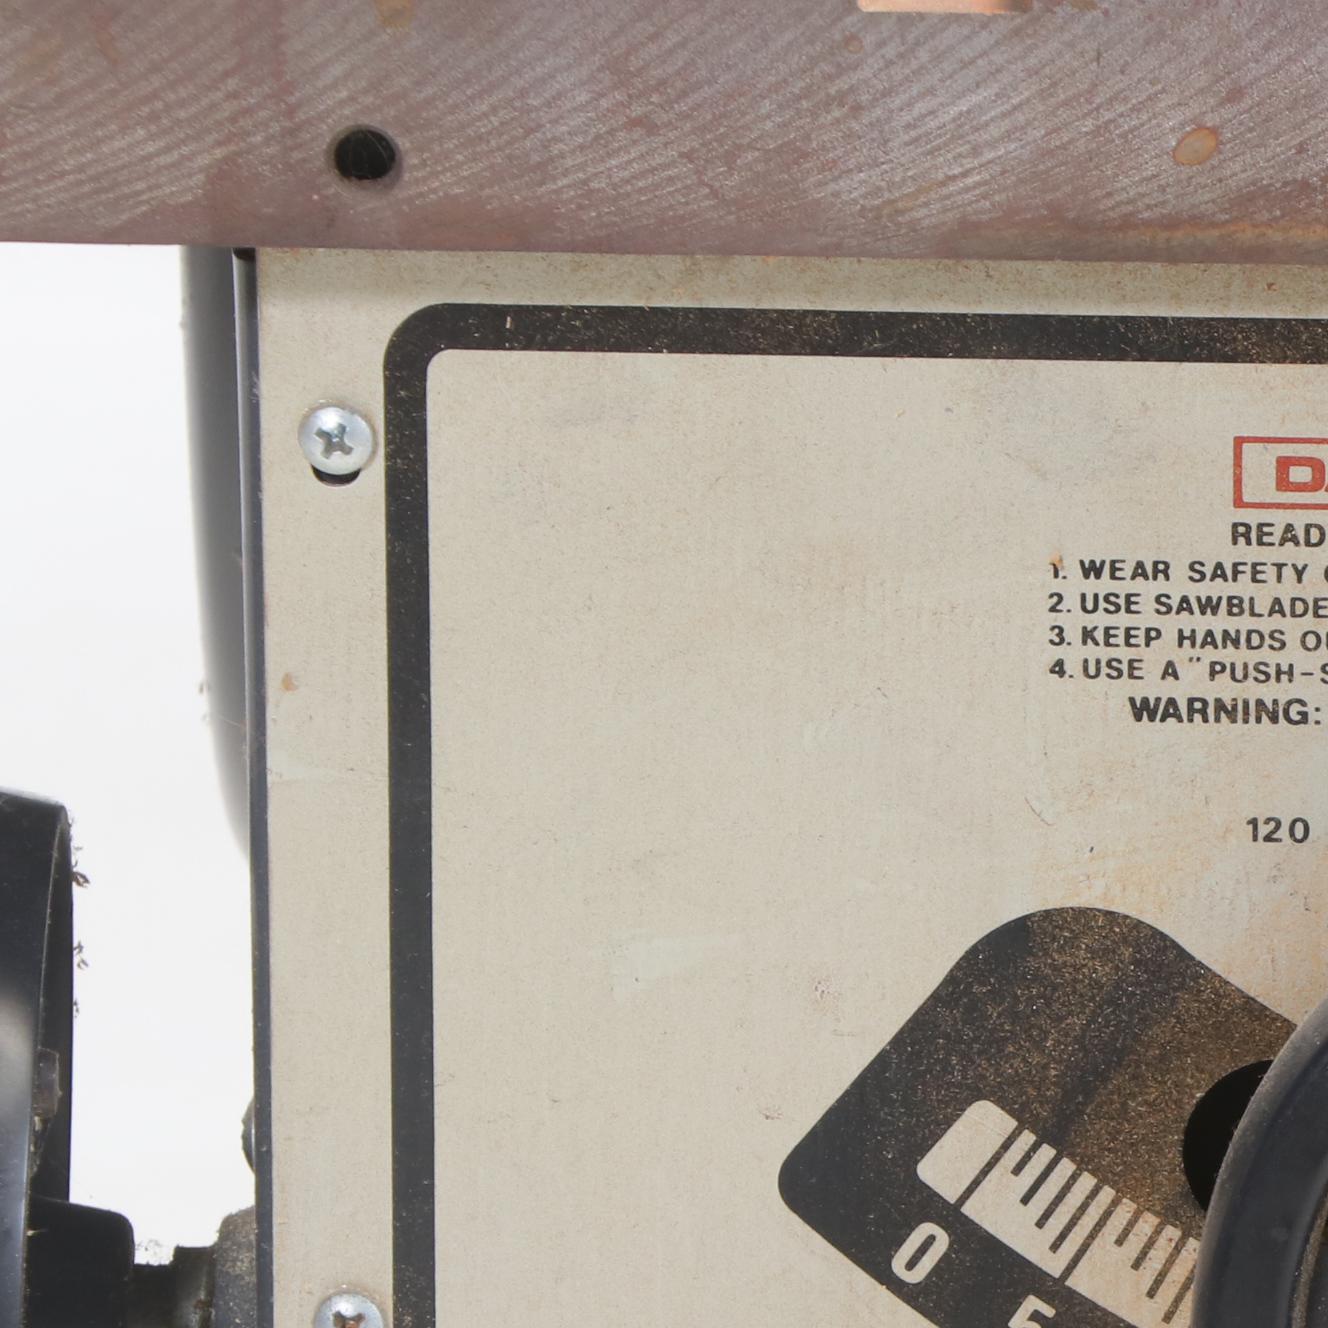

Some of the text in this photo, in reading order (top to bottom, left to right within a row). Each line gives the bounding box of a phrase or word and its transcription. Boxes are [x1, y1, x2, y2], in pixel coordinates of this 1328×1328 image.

[1231, 522, 1327, 548] READ
[1048, 561, 1068, 581] 1.
[1079, 559, 1171, 582] WEAR
[1188, 560, 1309, 585] SAFETY
[1047, 592, 1073, 614] 2.
[1080, 592, 1143, 615] USE
[1048, 625, 1073, 647] 3.
[1081, 625, 1163, 649] KEEP
[1177, 628, 1287, 652] HANDS
[1048, 658, 1074, 679] 4.
[1082, 658, 1145, 681] USE
[1160, 660, 1181, 682] A
[1128, 696, 1322, 726] WARNING:
[1246, 816, 1311, 844] 120
[891, 1221, 950, 1284] 0
